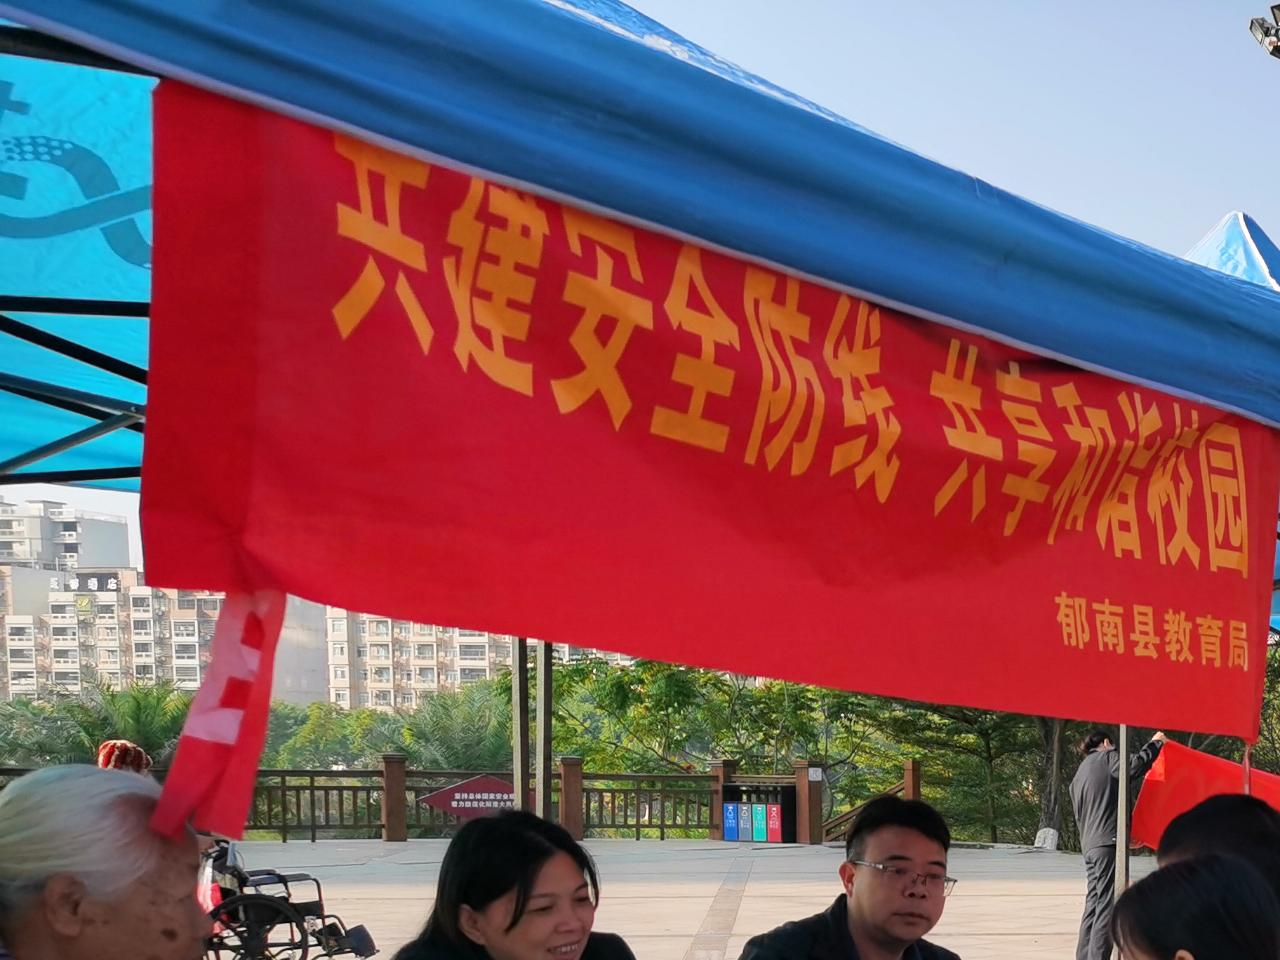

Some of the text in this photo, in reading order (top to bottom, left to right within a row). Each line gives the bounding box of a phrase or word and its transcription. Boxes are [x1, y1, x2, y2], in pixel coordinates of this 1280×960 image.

[332, 133, 1248, 578] 共建安全防线 共享和谐校园
[1055, 591, 1248, 672] 郁南县教育局
